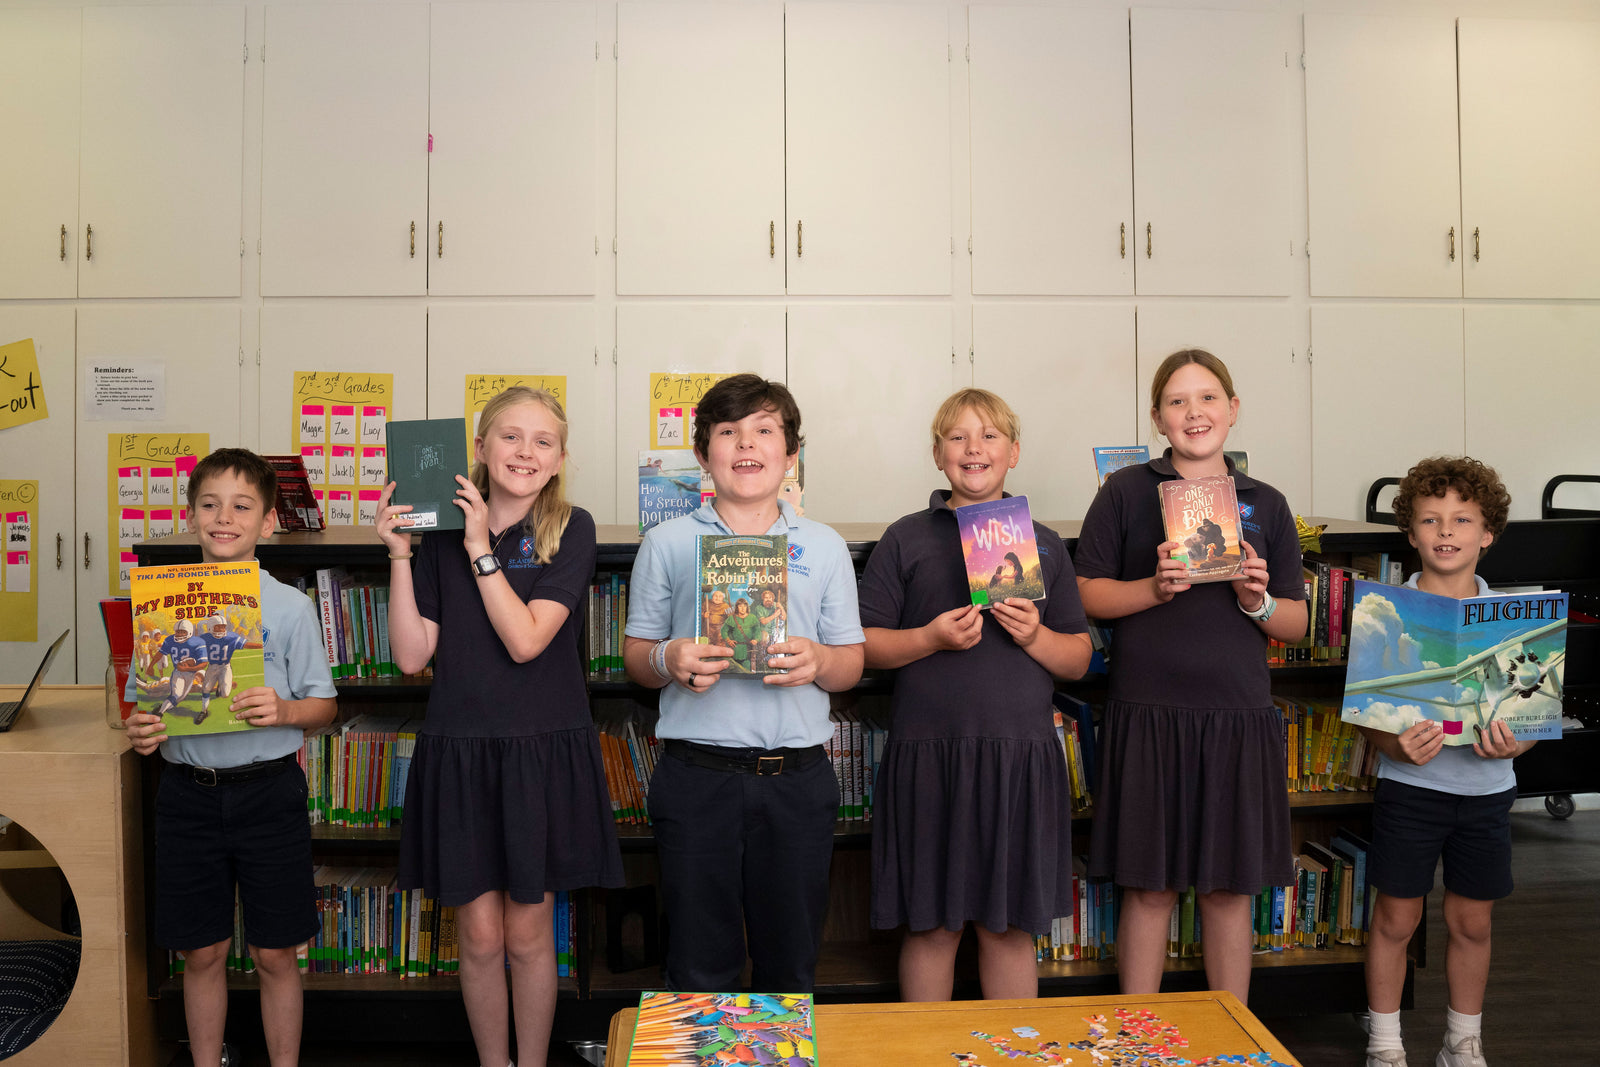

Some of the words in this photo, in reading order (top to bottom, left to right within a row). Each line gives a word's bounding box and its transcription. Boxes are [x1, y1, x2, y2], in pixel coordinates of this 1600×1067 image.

[344, 376, 385, 396] Grades
[334, 422, 350, 436] Zoe
[363, 422, 380, 440] Lucy
[659, 422, 678, 438] Zac
[146, 436, 194, 457] Grade
[332, 464, 348, 476] Jack
[119, 485, 143, 500] Georgia
[151, 484, 170, 494] Millie
[1184, 486, 1204, 502] ONE
[1192, 493, 1214, 512] ONLY
[1182, 506, 1214, 530] BOB
[972, 514, 1024, 552] Wish
[706, 554, 783, 568] Adventures
[212, 568, 252, 576] BARBER
[706, 572, 746, 586] Robin
[748, 572, 783, 586] Hood
[188, 582, 204, 592] BY
[135, 598, 160, 616] MY
[164, 592, 258, 608] BROTHER'S
[1462, 598, 1564, 626] FLIGHT
[175, 606, 220, 620] SIDE
[322, 600, 331, 625] CIRCUS
[210, 644, 228, 661] 21
[326, 627, 335, 664] MIRANDUS
